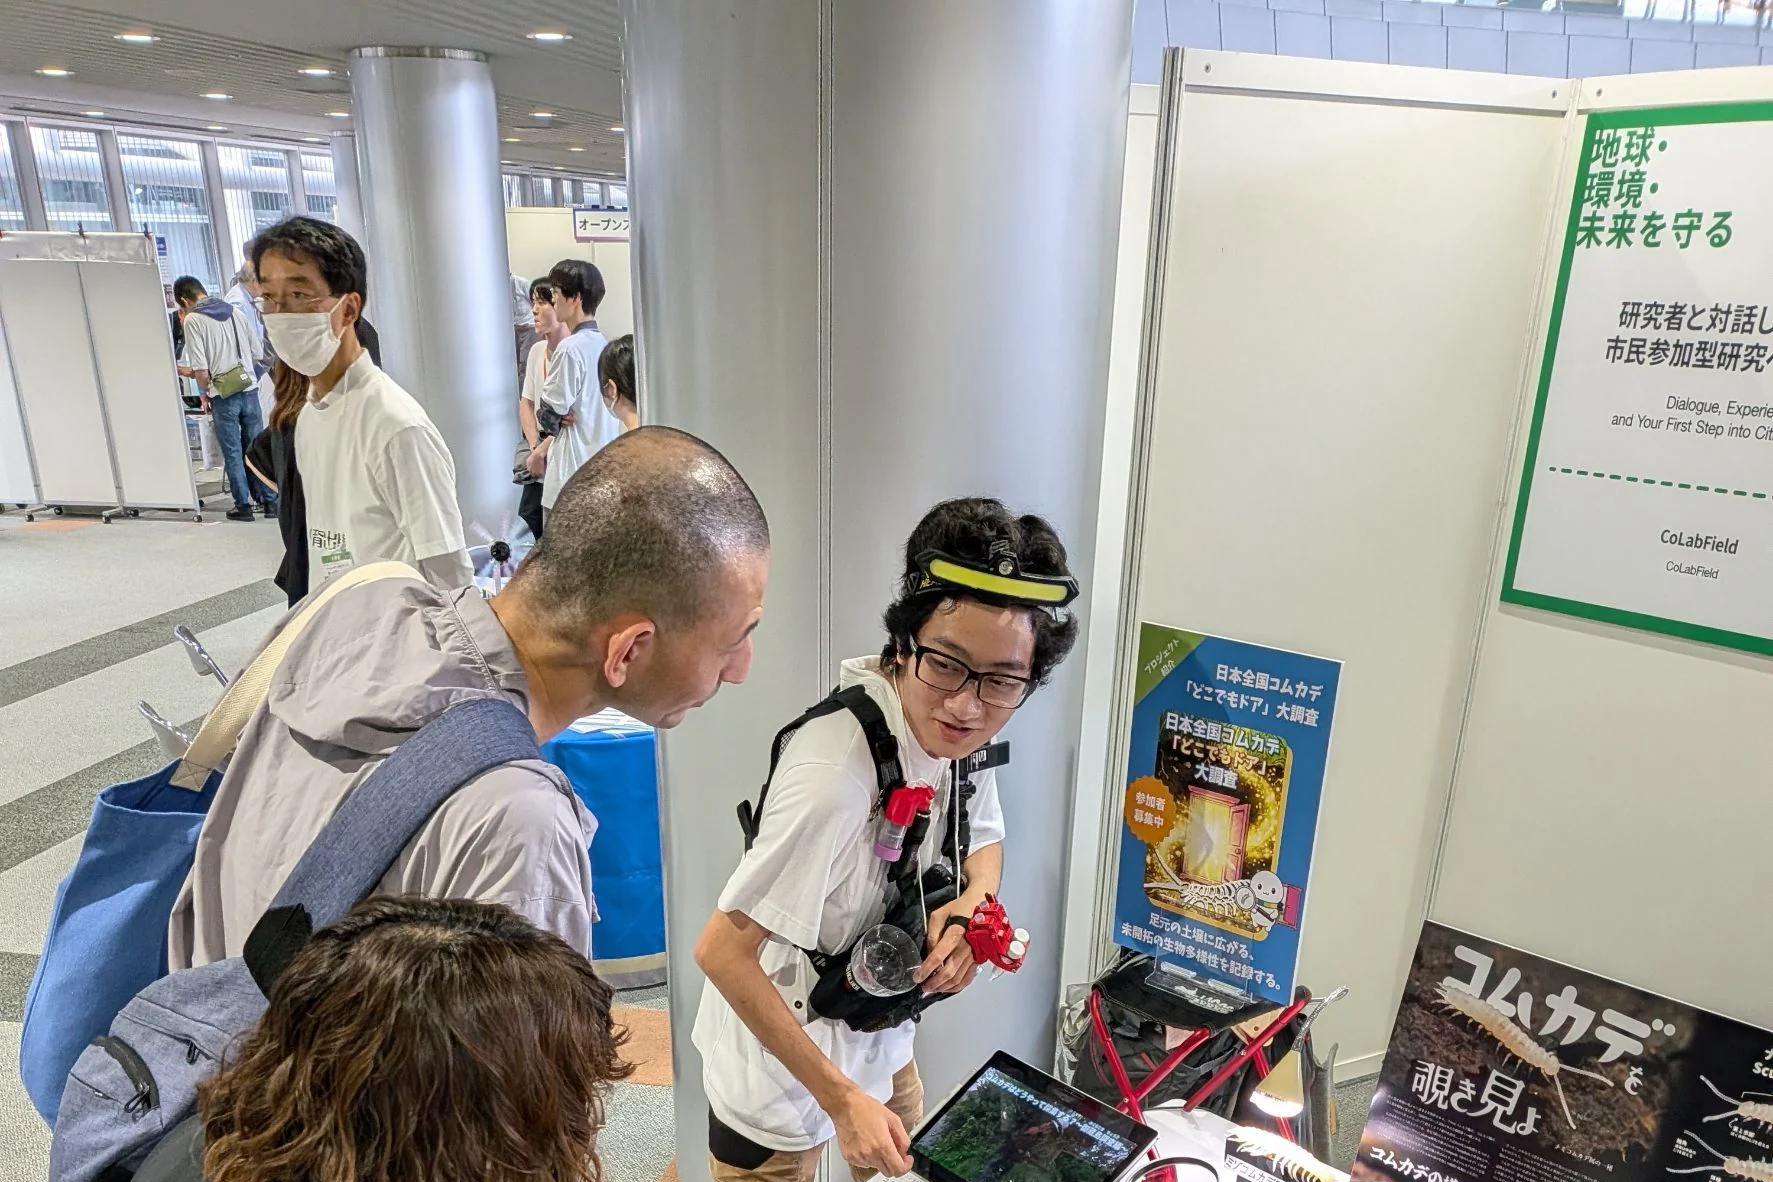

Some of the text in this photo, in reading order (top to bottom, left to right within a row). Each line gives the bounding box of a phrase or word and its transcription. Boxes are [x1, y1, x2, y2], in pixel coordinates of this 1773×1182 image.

[1576, 208, 1733, 249] 未来を守る
[1618, 301, 1773, 334] 研究者と対話し
[1666, 395, 1722, 415] Dialogue,
[1611, 414, 1634, 427] and
[1637, 414, 1664, 429] Your
[1666, 417, 1693, 432] First
[1695, 420, 1724, 438] Step
[1727, 423, 1751, 439] into
[1660, 529, 1740, 555] CoLabField
[1666, 560, 1720, 580] CoLabField
[1144, 638, 1180, 675] プロジェクト
[1160, 659, 1176, 677] 紹介
[1215, 663, 1324, 702] 日本全国コムカデ
[1165, 712, 1281, 756] 日本全国コムカデ
[1172, 735, 1267, 776] 「どこでもドア」
[1195, 763, 1239, 789] 大調査
[1135, 791, 1166, 812] 参加者
[1133, 809, 1165, 829] 募集中
[1412, 1060, 1542, 1136] 覗き見よ
